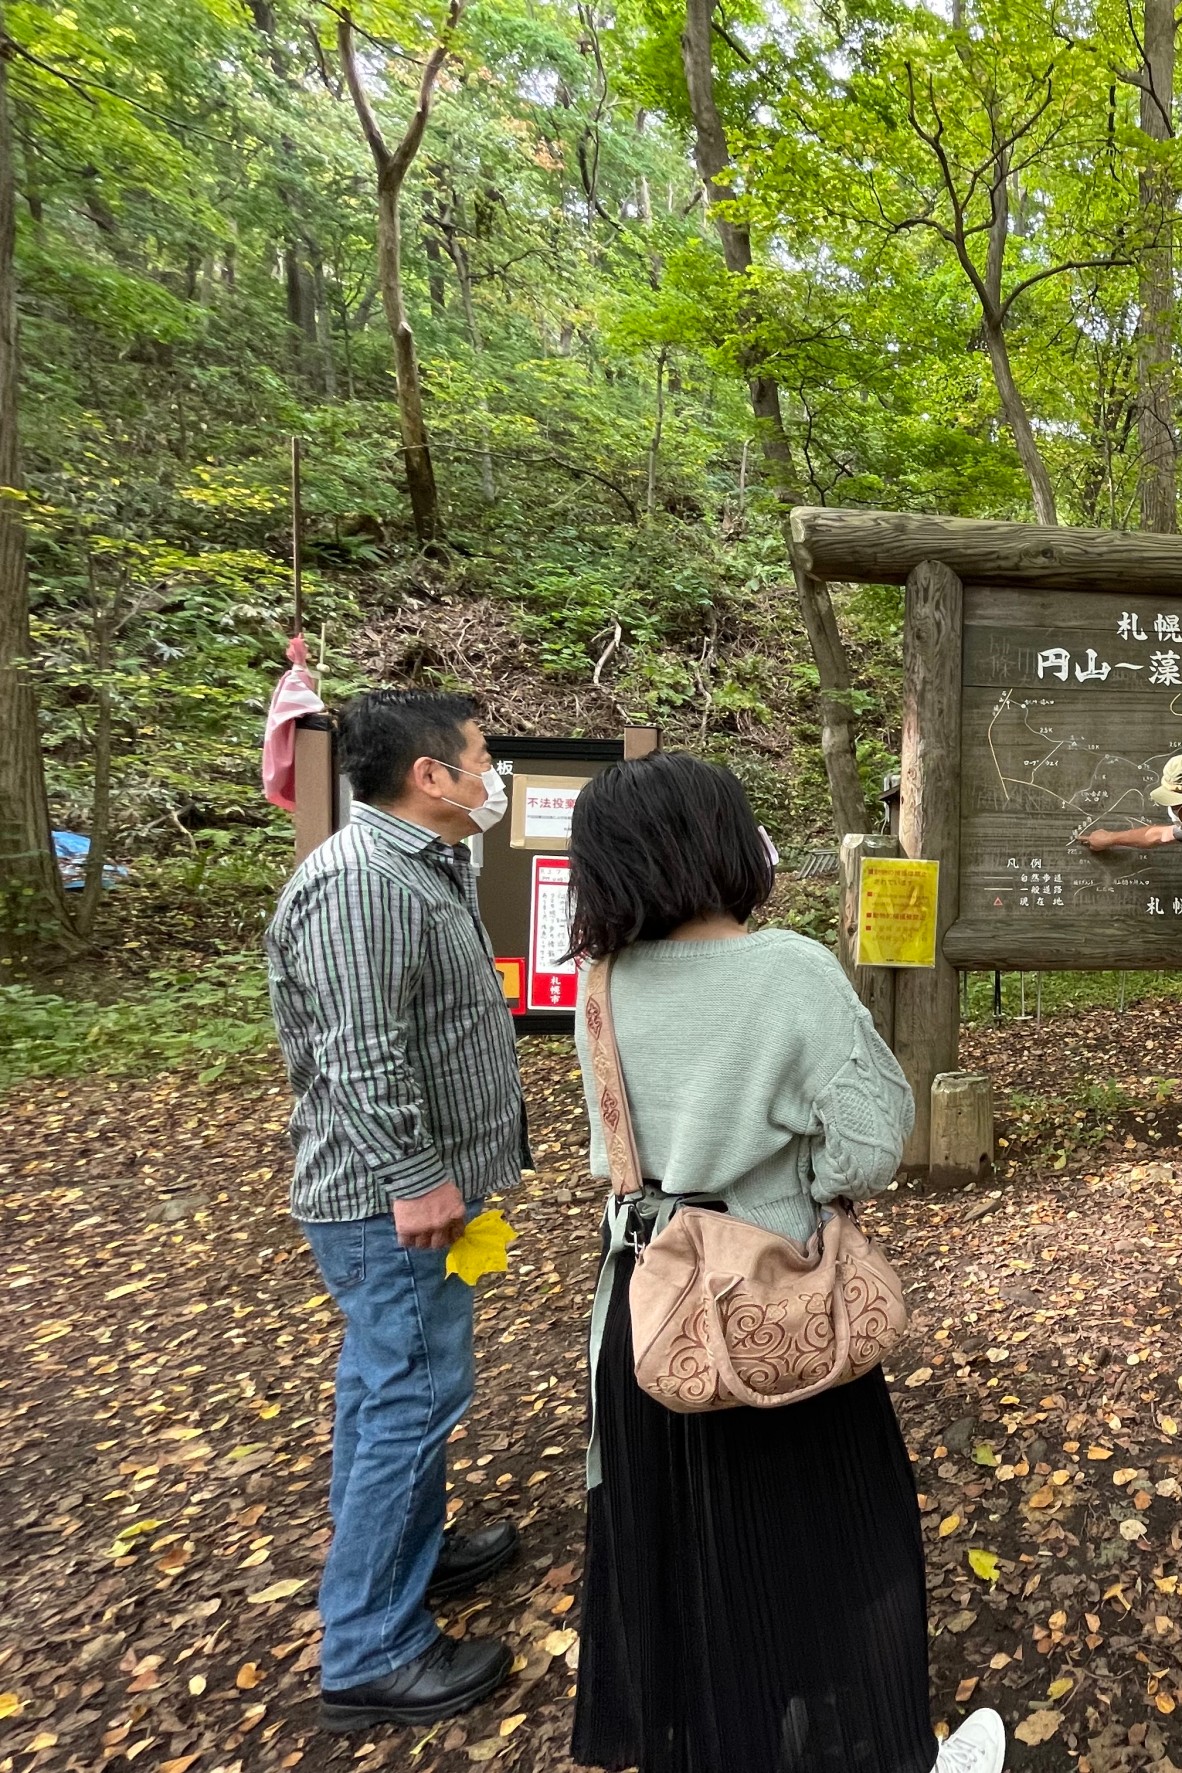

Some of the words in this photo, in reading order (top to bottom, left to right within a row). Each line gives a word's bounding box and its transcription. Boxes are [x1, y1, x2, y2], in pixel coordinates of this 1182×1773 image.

[497, 760, 514, 776] 板
[1006, 857, 1042, 869] 凡例
[1020, 873, 1064, 884] 自然歩道
[1020, 885, 1064, 895] 一般道路
[1020, 897, 1065, 907] 現在地
[550, 975, 561, 1005] 札幌市
